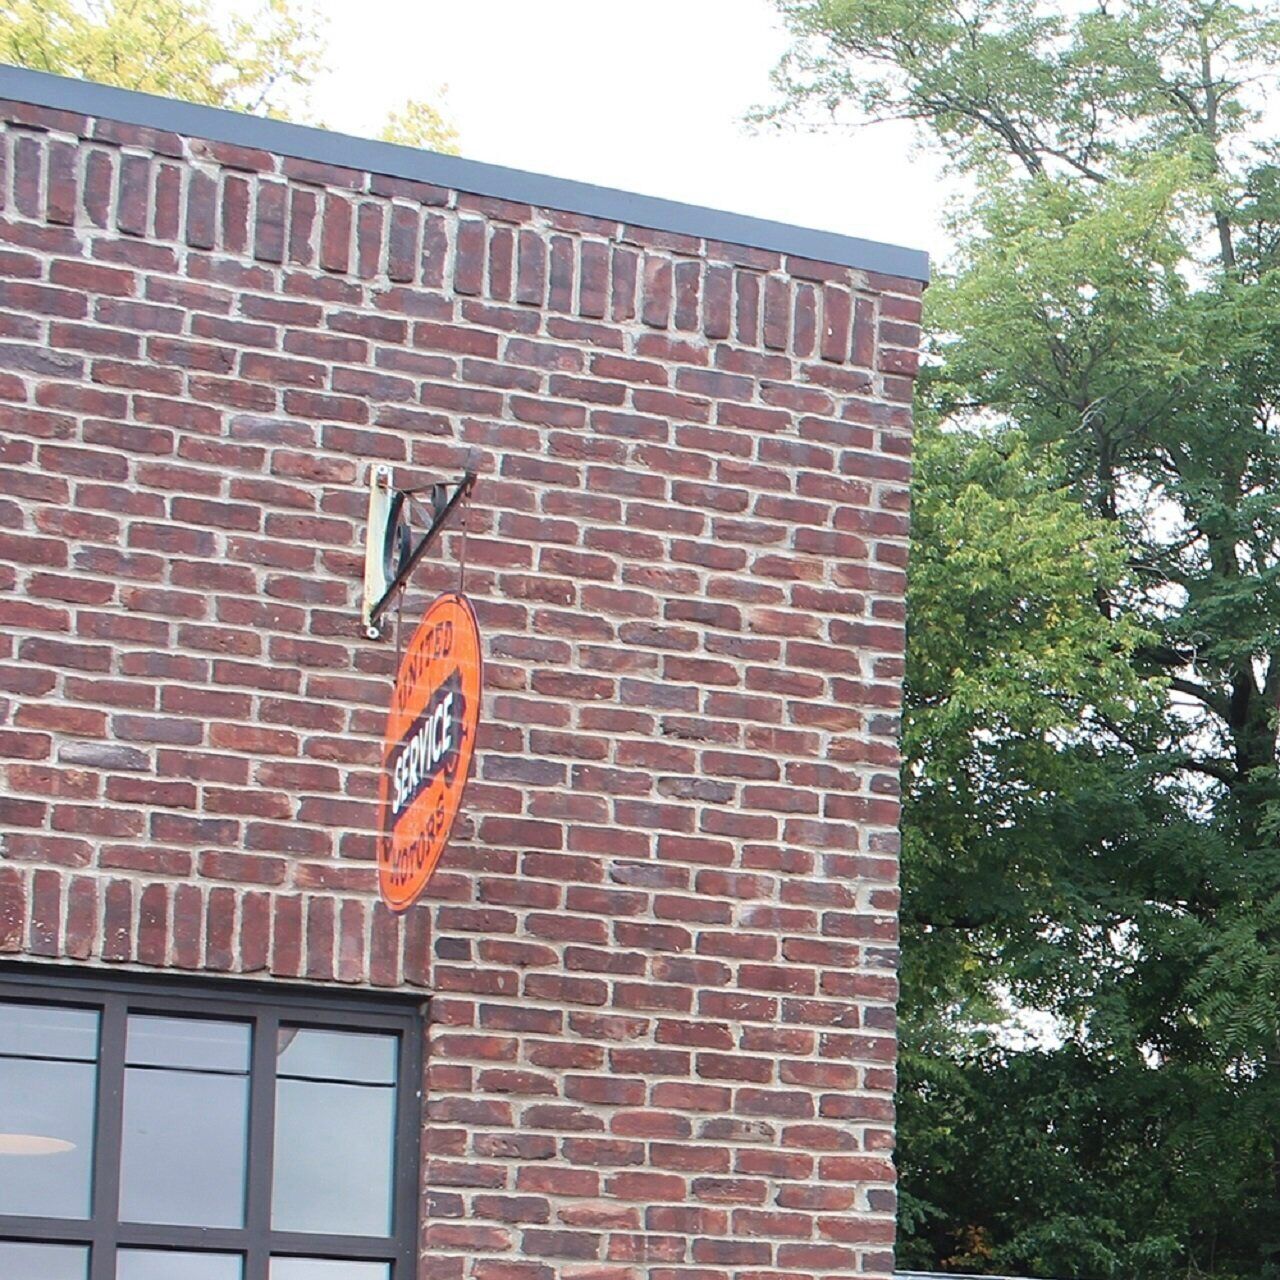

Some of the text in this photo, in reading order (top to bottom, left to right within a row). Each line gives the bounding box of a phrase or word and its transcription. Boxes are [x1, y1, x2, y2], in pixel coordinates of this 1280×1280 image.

[398, 620, 453, 711] UNITED
[392, 691, 454, 814] SERVICE
[390, 794, 445, 886] MOTORS
